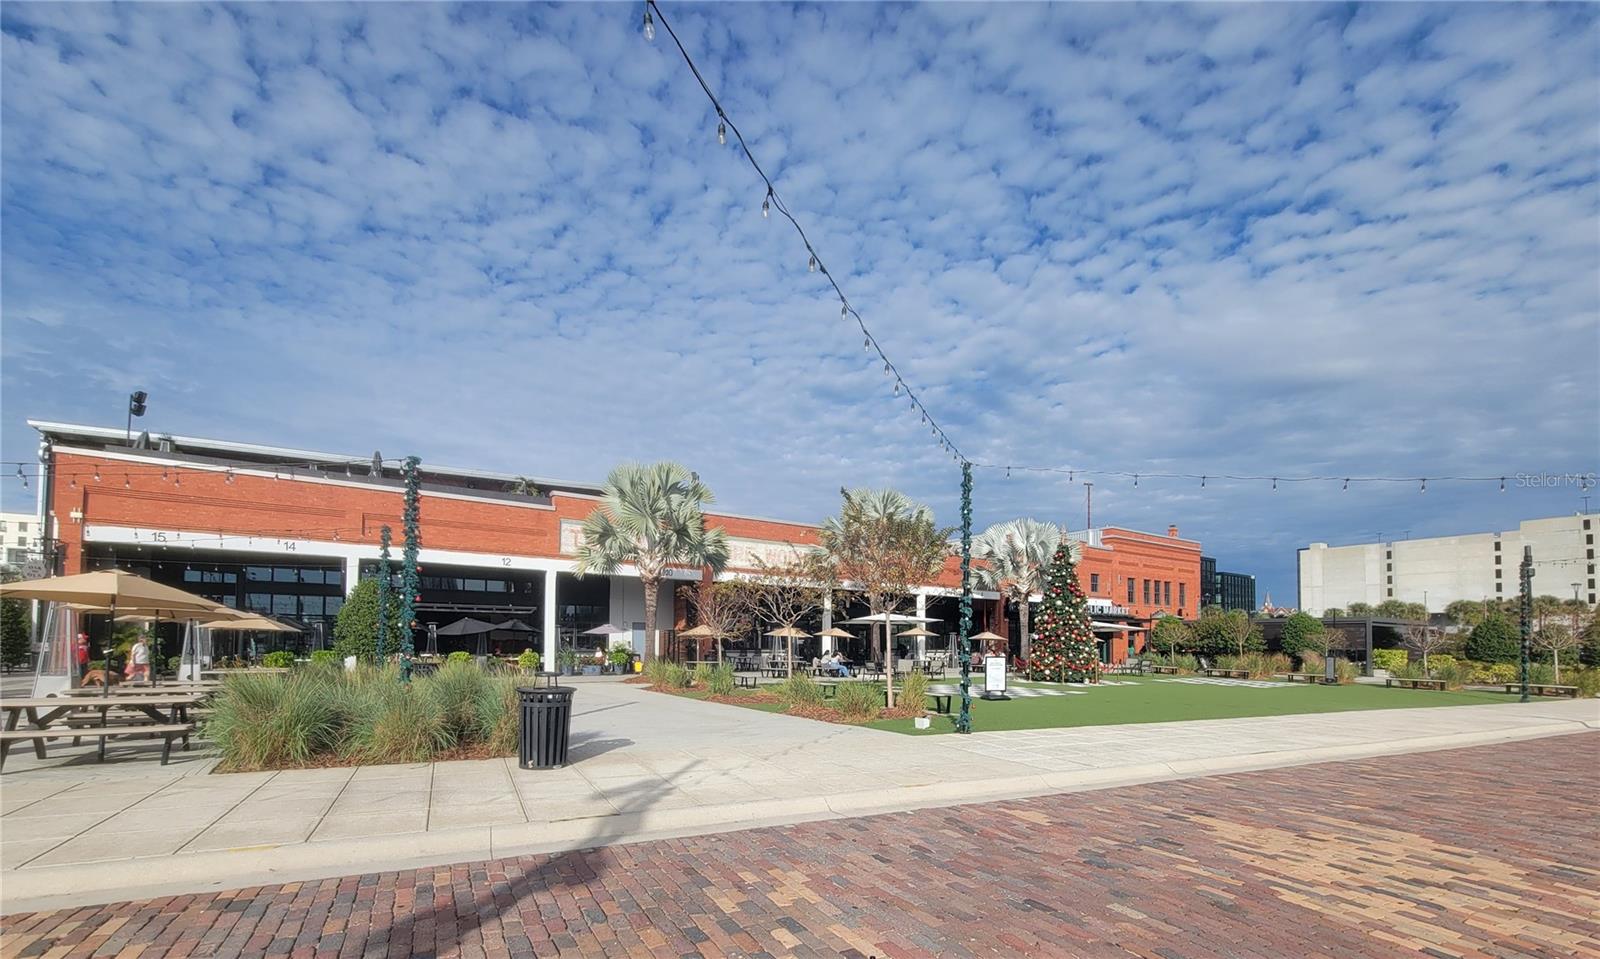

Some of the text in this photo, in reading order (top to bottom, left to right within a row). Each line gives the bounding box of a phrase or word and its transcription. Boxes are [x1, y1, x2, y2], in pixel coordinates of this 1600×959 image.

[151, 532, 167, 543] 15
[283, 541, 297, 552] 14
[501, 557, 512, 567] 12
